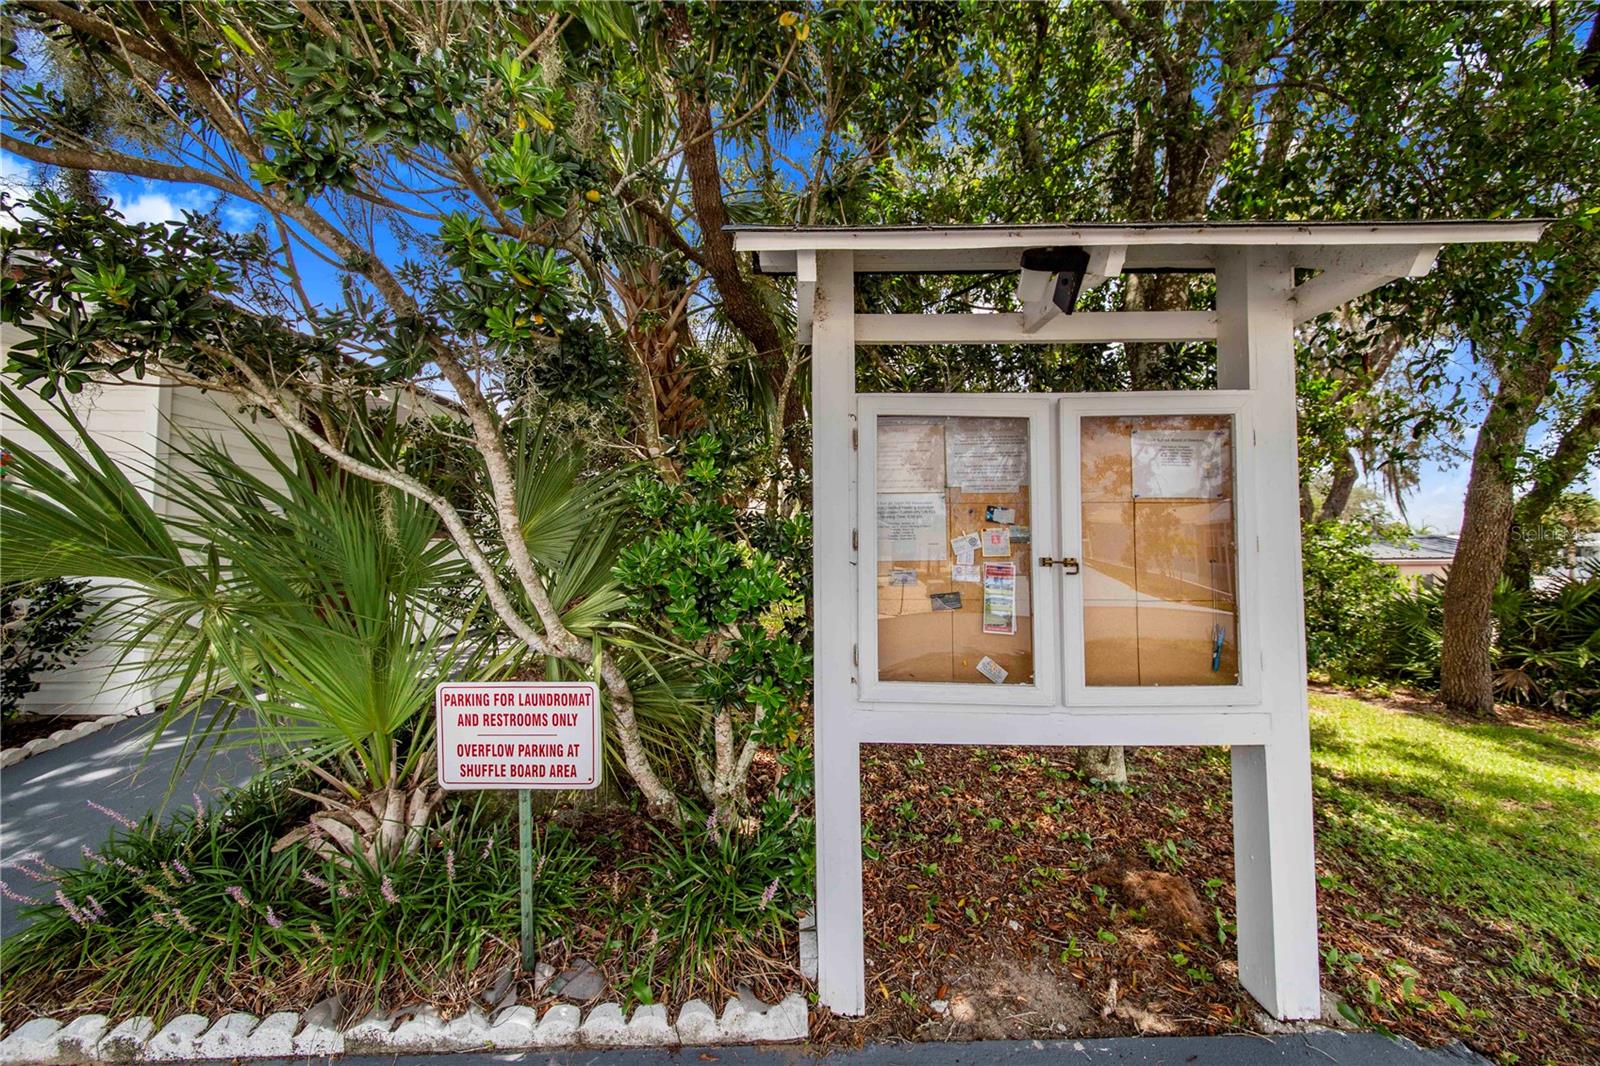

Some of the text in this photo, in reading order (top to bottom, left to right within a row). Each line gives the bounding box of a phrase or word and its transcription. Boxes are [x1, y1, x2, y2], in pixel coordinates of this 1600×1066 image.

[444, 693, 591, 707] PARKING FOR LAUNDROMAT
[457, 713, 578, 727] AND RESTROOMS ONLY
[457, 743, 580, 758] OVERFLOW PARKING AT
[460, 764, 577, 778] SHUFFLE BOARD AREA
